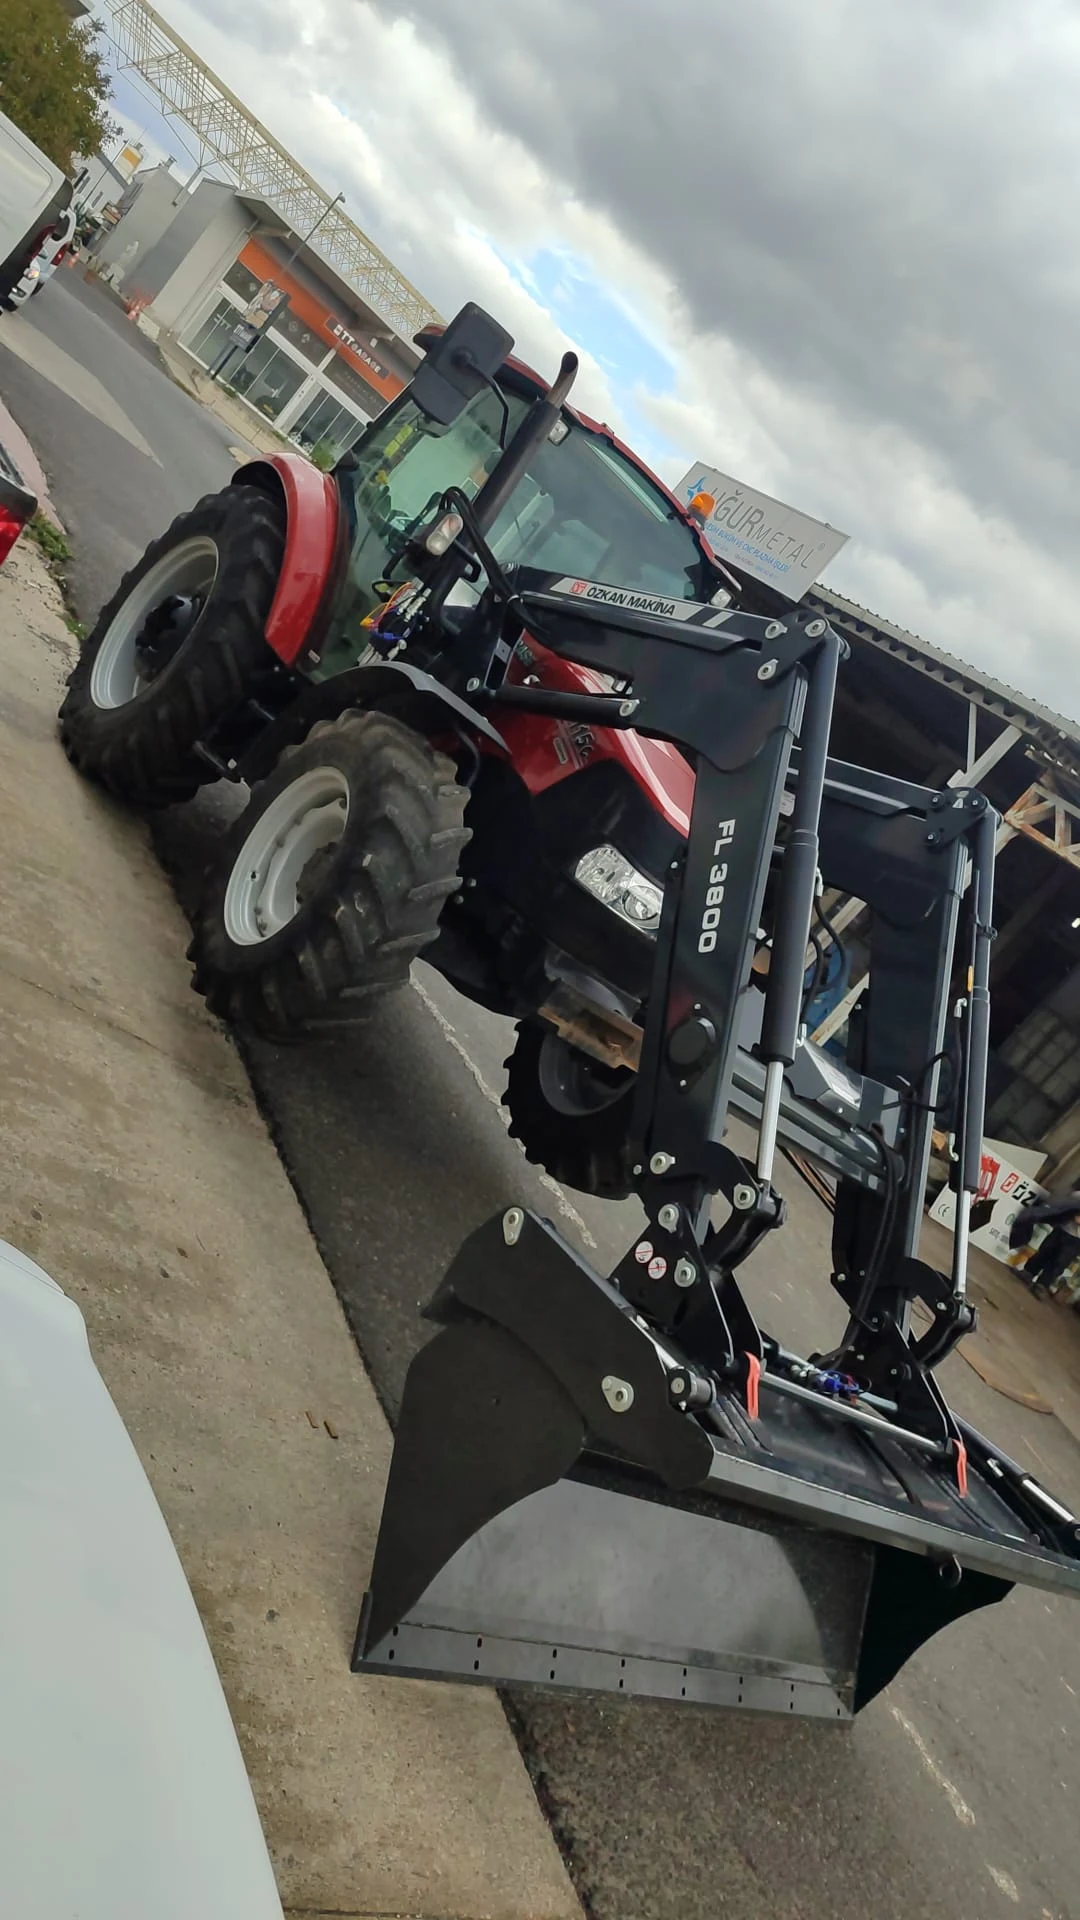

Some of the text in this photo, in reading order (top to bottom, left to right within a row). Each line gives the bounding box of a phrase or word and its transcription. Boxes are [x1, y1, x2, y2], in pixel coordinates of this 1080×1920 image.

[627, 596, 675, 616] MAKİNA
[698, 818, 736, 953] FL 3800
